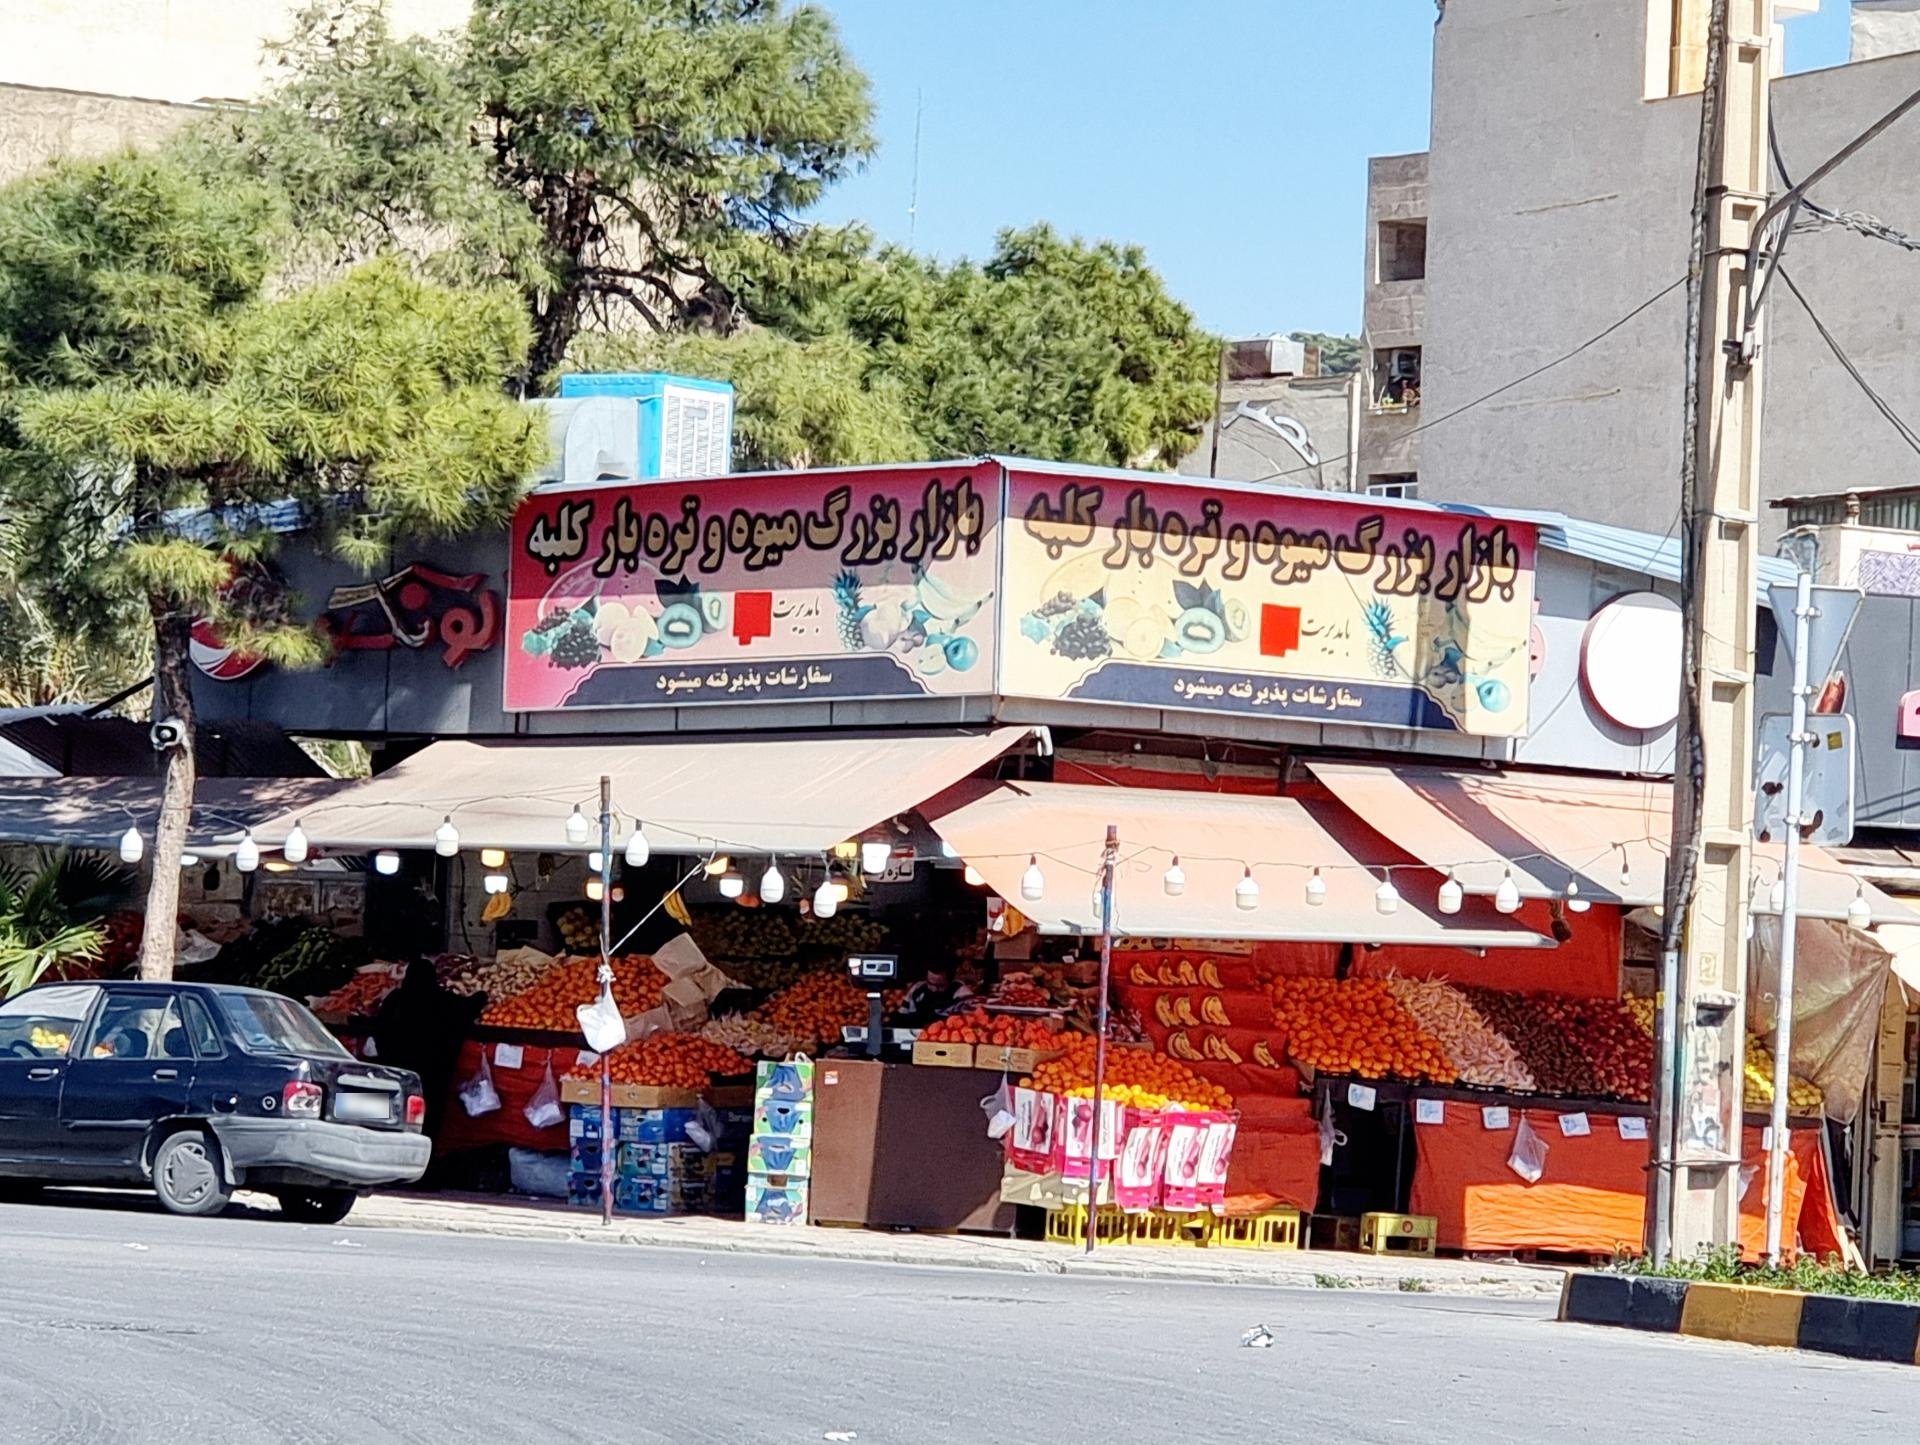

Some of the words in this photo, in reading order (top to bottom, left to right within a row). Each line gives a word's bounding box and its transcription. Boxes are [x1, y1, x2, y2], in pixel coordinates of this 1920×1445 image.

[527, 501, 593, 575] کلبه
[594, 498, 641, 576] بار
[645, 496, 699, 574] تره
[699, 516, 726, 573] و
[728, 509, 799, 570] میوه
[805, 486, 898, 563] بزرگ
[902, 478, 983, 561] بازار
[1025, 483, 1103, 560] کلبه
[1102, 489, 1158, 569] بار
[1160, 499, 1222, 576] تره
[1222, 523, 1250, 581] و
[1253, 520, 1331, 585] میوه
[1334, 515, 1435, 595] بزرگ
[1435, 523, 1519, 602] بازار
[772, 599, 813, 634] مدیریت
[1301, 618, 1344, 655] مدیریت
[656, 671, 702, 695] میشود
[706, 668, 761, 692] پذیرفته
[765, 665, 833, 690] سفارشات
[1173, 677, 1224, 699] میشود
[1228, 679, 1288, 707] پذیرفته
[1292, 684, 1362, 710] سفارشات
